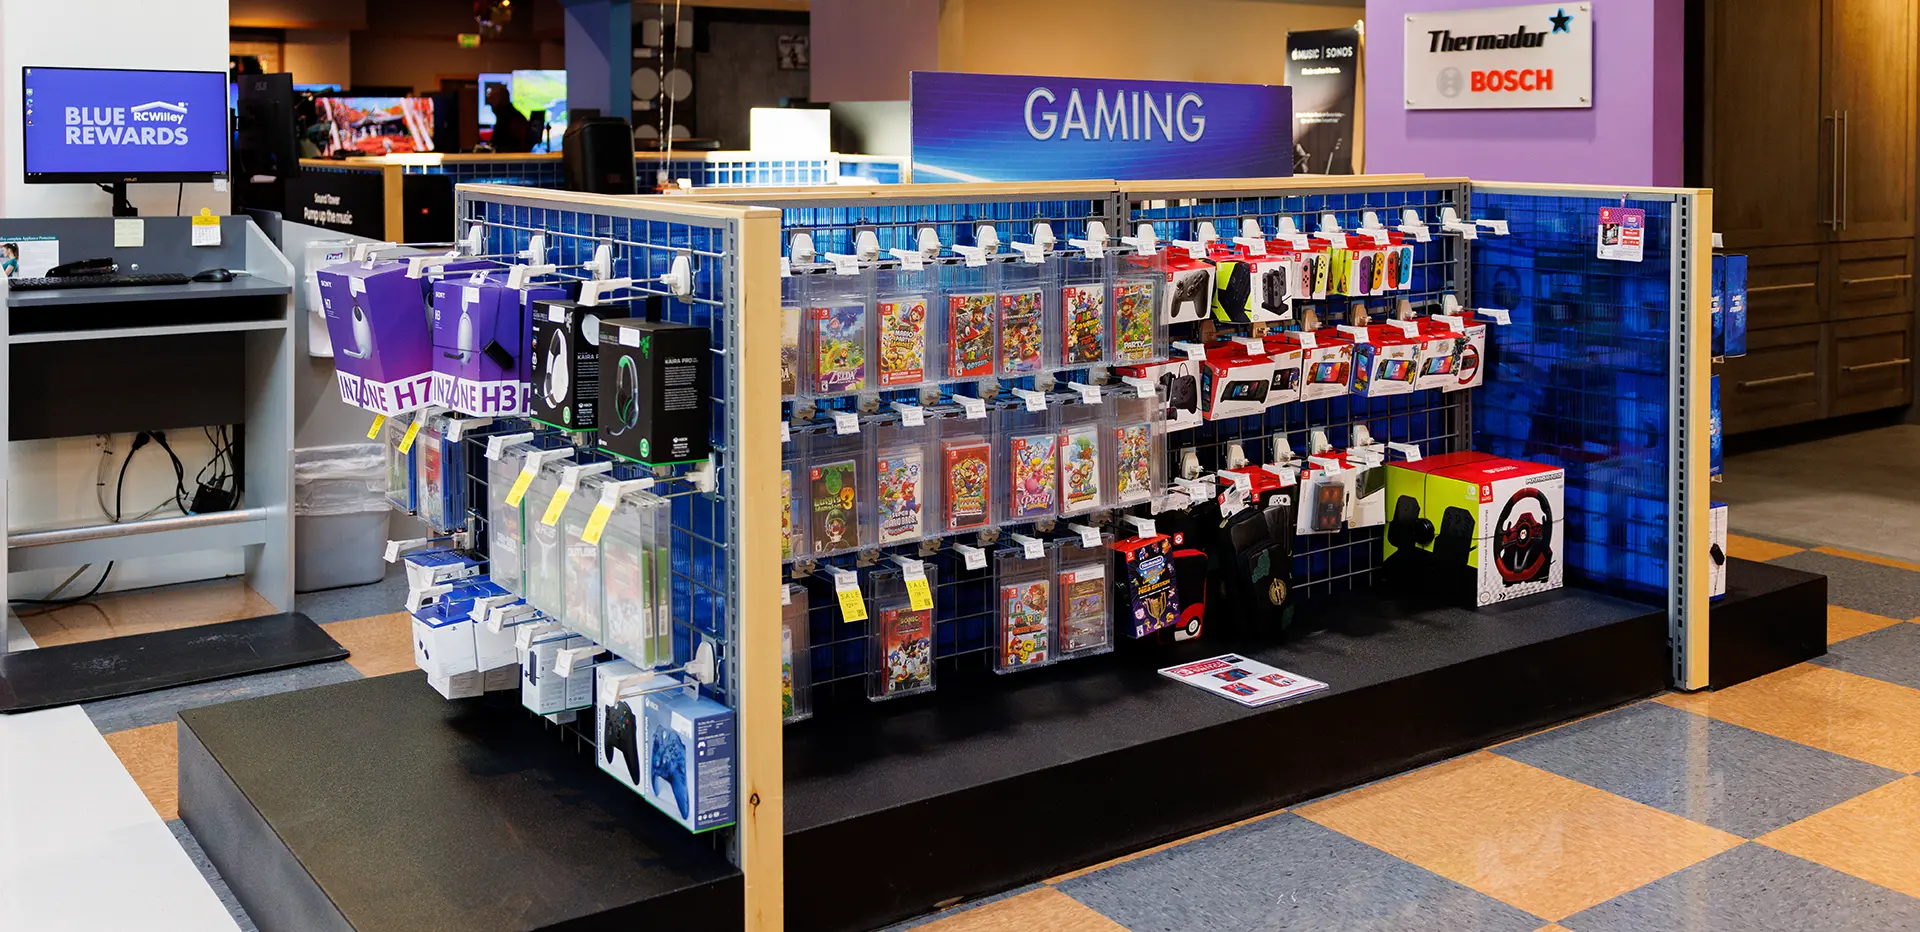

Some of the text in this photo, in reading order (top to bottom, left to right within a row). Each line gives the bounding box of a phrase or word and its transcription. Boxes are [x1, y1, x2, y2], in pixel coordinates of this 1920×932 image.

[1427, 25, 1548, 53] Thermador
[1297, 46, 1353, 60] MUSIC SONOS
[1470, 69, 1553, 92] BOSCH
[65, 106, 126, 126] BLUE
[133, 111, 184, 125] RCWilley
[1023, 86, 1207, 143] GAMING
[65, 126, 189, 146] REWARDS
[304, 206, 318, 225] Pump
[339, 375, 388, 412] INZONE
[394, 376, 432, 410] H7
[433, 375, 476, 412] INZONE
[481, 385, 517, 413] H3
[840, 487, 855, 510] 3
[840, 591, 860, 600] SALE
[908, 581, 927, 589] SALE
